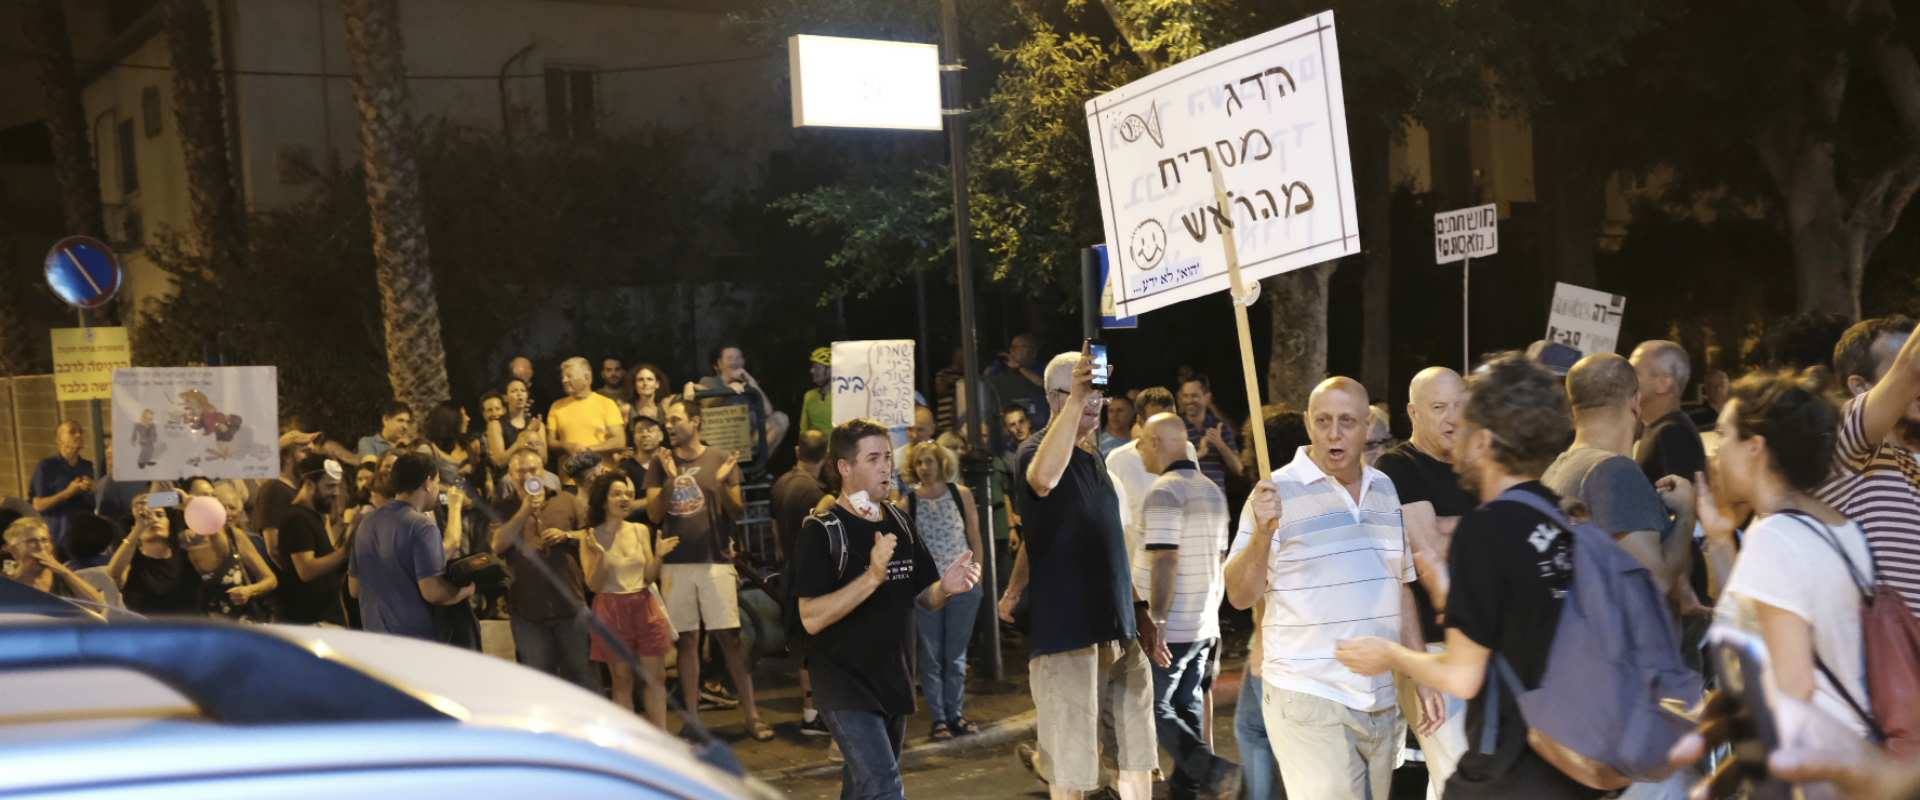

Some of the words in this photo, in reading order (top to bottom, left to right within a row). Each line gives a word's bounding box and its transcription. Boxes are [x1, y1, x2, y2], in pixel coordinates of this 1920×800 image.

[1224, 66, 1296, 117] הדג
[1158, 129, 1273, 189] מסריח
[1437, 208, 1494, 234] מושחתים
[832, 376, 865, 394] ביבי
